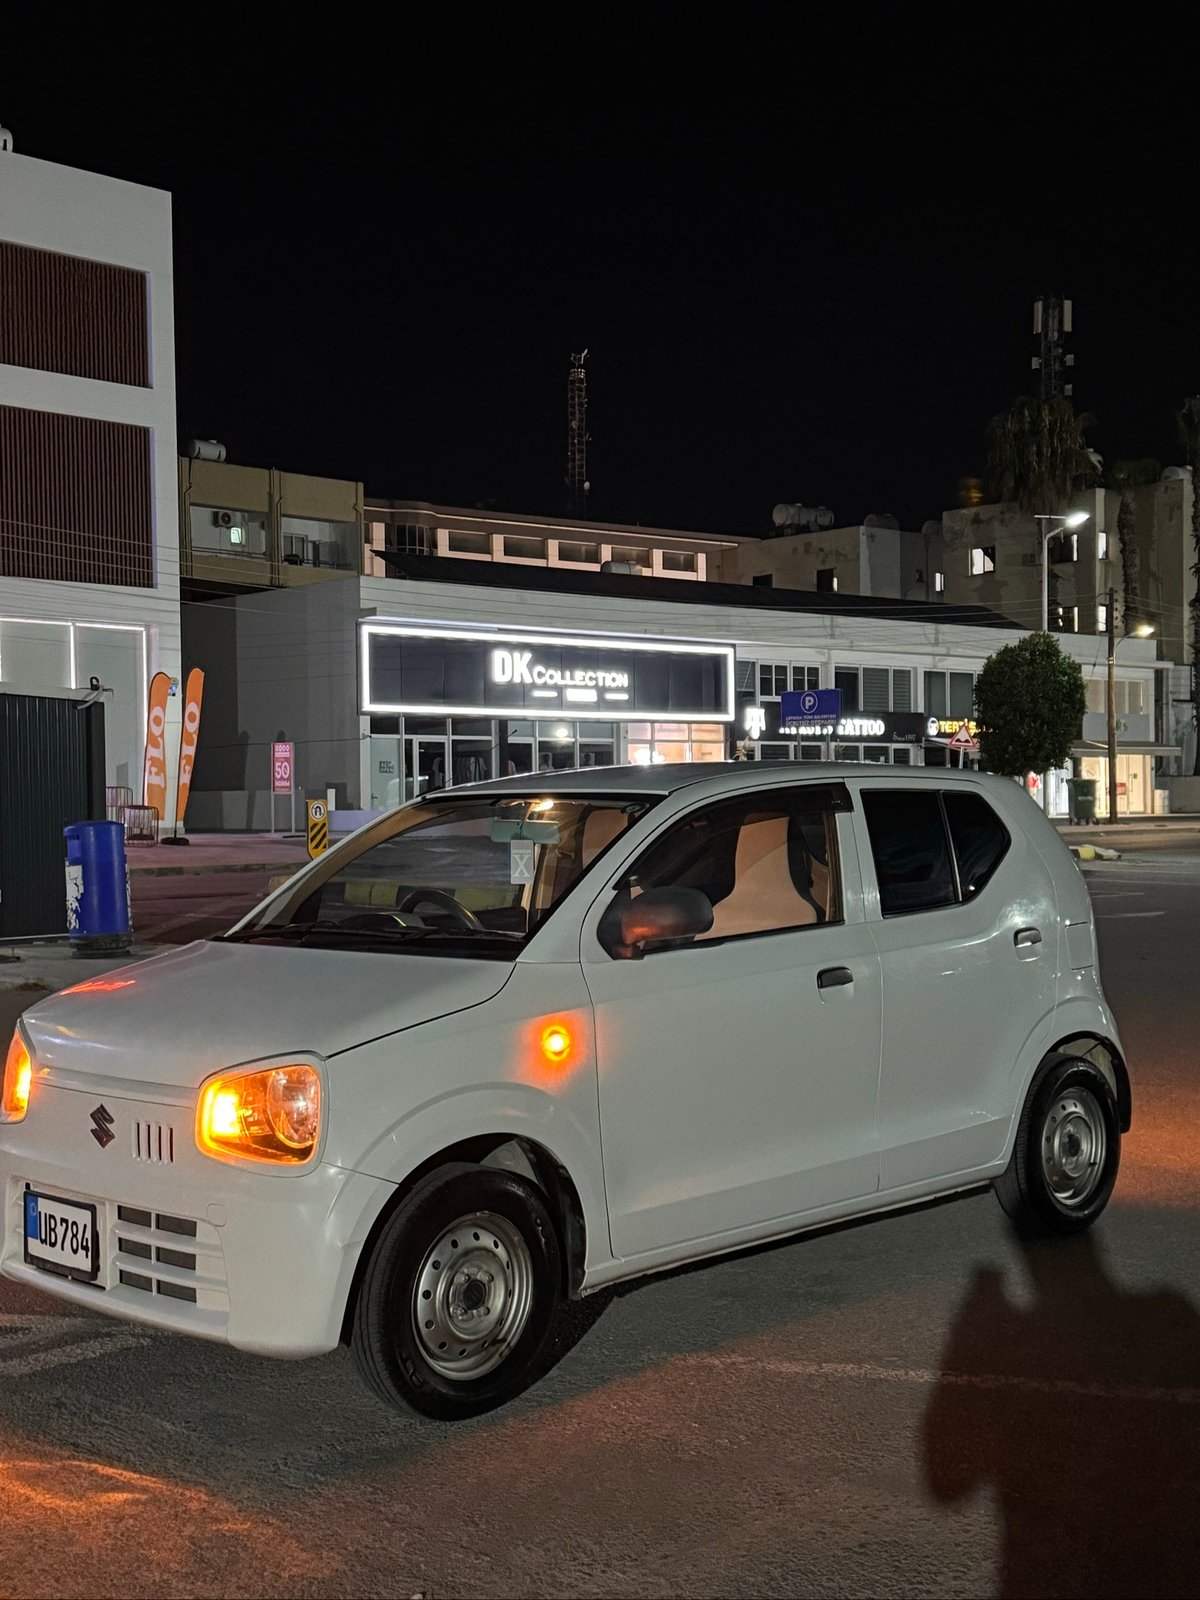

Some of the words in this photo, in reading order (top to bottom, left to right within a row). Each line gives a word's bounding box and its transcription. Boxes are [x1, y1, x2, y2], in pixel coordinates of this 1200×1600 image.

[493, 650, 533, 684] DK
[532, 666, 629, 688] COLLECTION
[805, 697, 815, 709] P
[145, 706, 166, 789] FLO
[180, 702, 200, 785] FLO
[274, 762, 290, 779] 50
